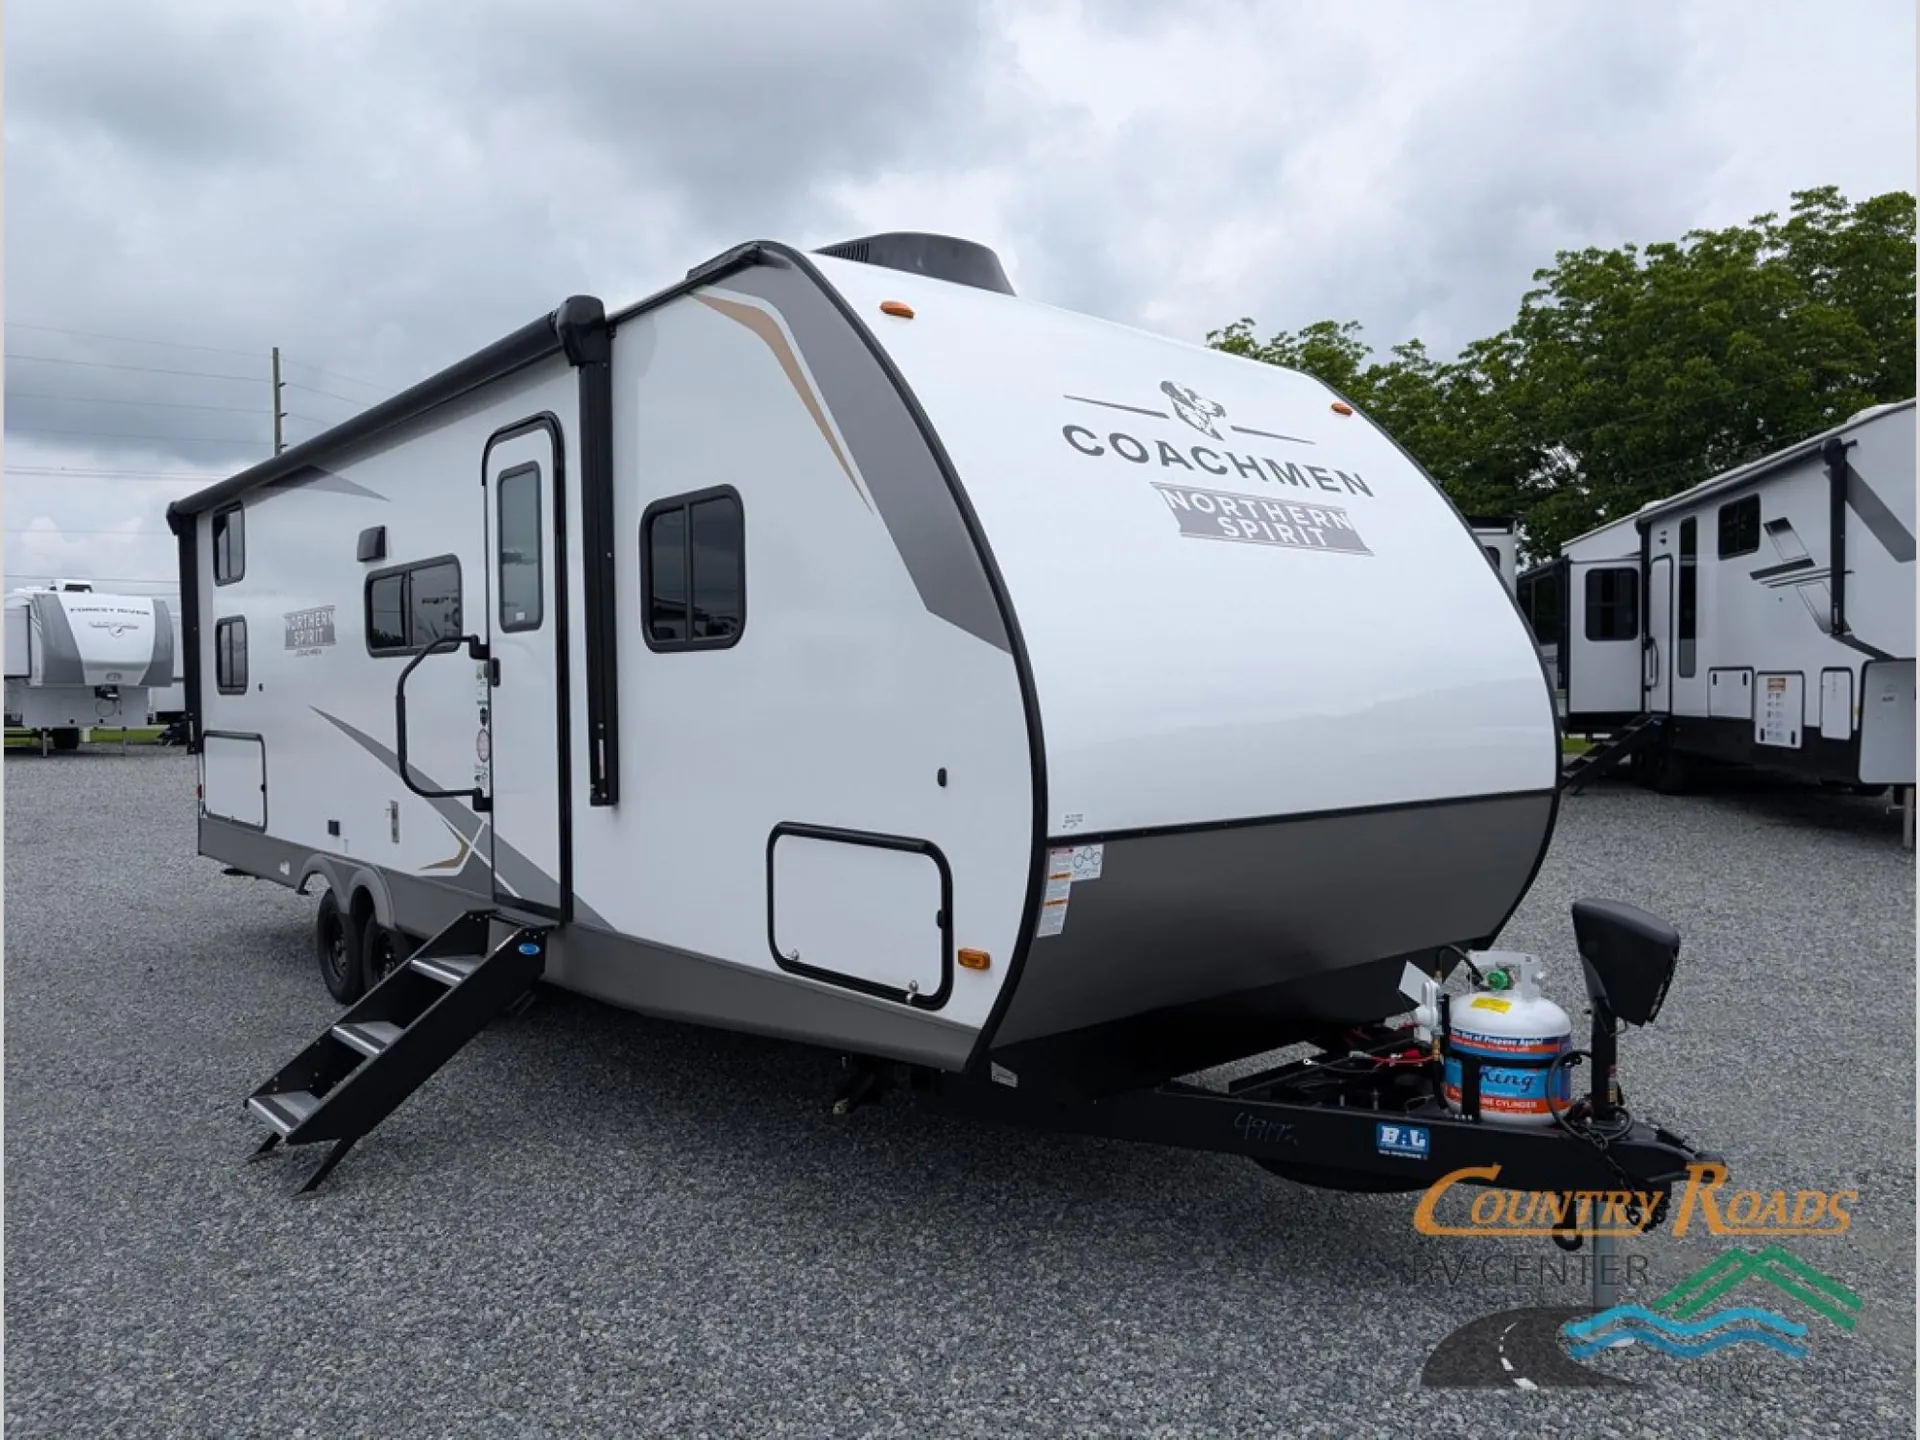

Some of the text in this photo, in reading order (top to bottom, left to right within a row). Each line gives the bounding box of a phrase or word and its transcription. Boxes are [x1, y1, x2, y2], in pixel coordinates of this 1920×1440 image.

[1062, 424, 1375, 497] COACHMEN
[1160, 489, 1354, 530] NORTHERN
[1218, 516, 1327, 546] SPIRIT
